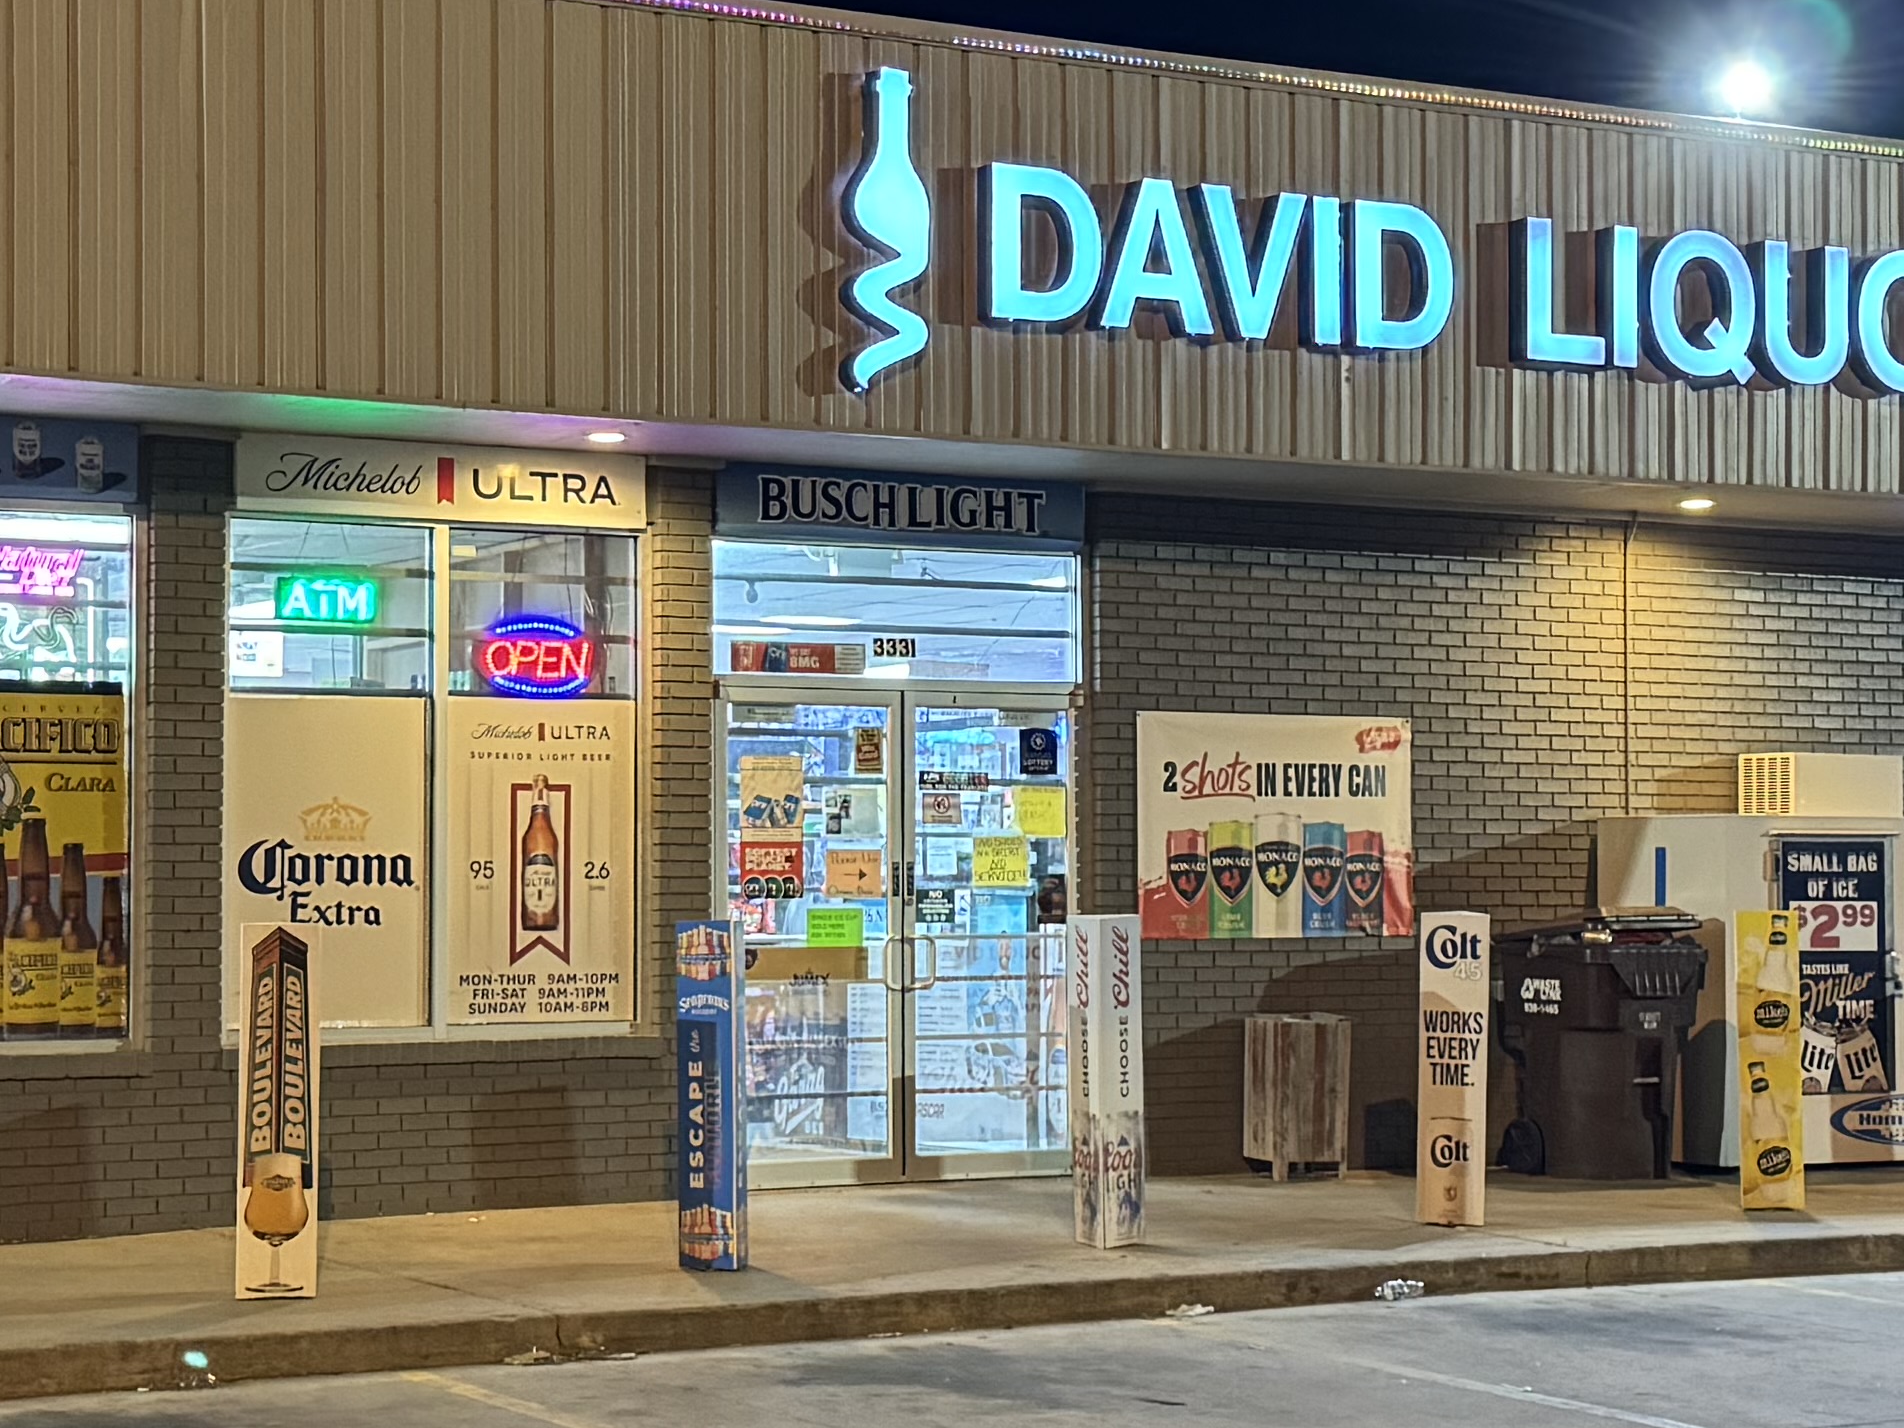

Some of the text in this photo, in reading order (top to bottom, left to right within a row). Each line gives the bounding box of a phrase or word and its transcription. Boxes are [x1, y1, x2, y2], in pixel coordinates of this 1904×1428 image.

[989, 160, 1455, 350] DAVID
[265, 453, 620, 506] Michelob ULTRA
[758, 475, 1046, 534] BUSCH LIGHT
[283, 583, 370, 620] ATM
[485, 641, 590, 681] OPEN
[471, 723, 611, 741] Michelob ULTRA
[469, 751, 533, 761] SUPERIOR
[539, 753, 576, 762] LIGHT
[44, 772, 117, 794] CLARA
[1163, 751, 1386, 798] 2 shots IN EVERY CAN
[238, 839, 415, 901] Corona
[469, 860, 611, 880] 95 2.6
[1257, 850, 1300, 862] MONACO
[1787, 851, 1878, 872] SMALL BAG
[1807, 878, 1859, 898] OF ICE
[289, 891, 382, 928] Extra
[1425, 924, 1482, 969] Colt
[459, 973, 620, 987] MON-THUR 9AM-10PM
[1453, 960, 1483, 981] 45
[468, 1001, 610, 1016] SUNDAY 10AM-8PM
[472, 987, 606, 1001] FRI-SAT 9AM-11PM
[1800, 972, 1876, 1015] Miller
[1835, 1000, 1876, 1020] TIME
[1112, 925, 1129, 1098] CHOOSE Chill
[1423, 1009, 1484, 1035] WORKS
[283, 975, 306, 1150] BOULEVARD
[1426, 1036, 1480, 1061] EVERY
[1801, 1040, 1835, 1073] Lite
[1844, 1042, 1878, 1080] Lite
[249, 977, 275, 1154] BOULEVARD
[1429, 1062, 1475, 1087] TIME.
[688, 1060, 704, 1189] ESCAPE
[1858, 1112, 1904, 1127] Home
[1430, 1133, 1471, 1169] Colt
